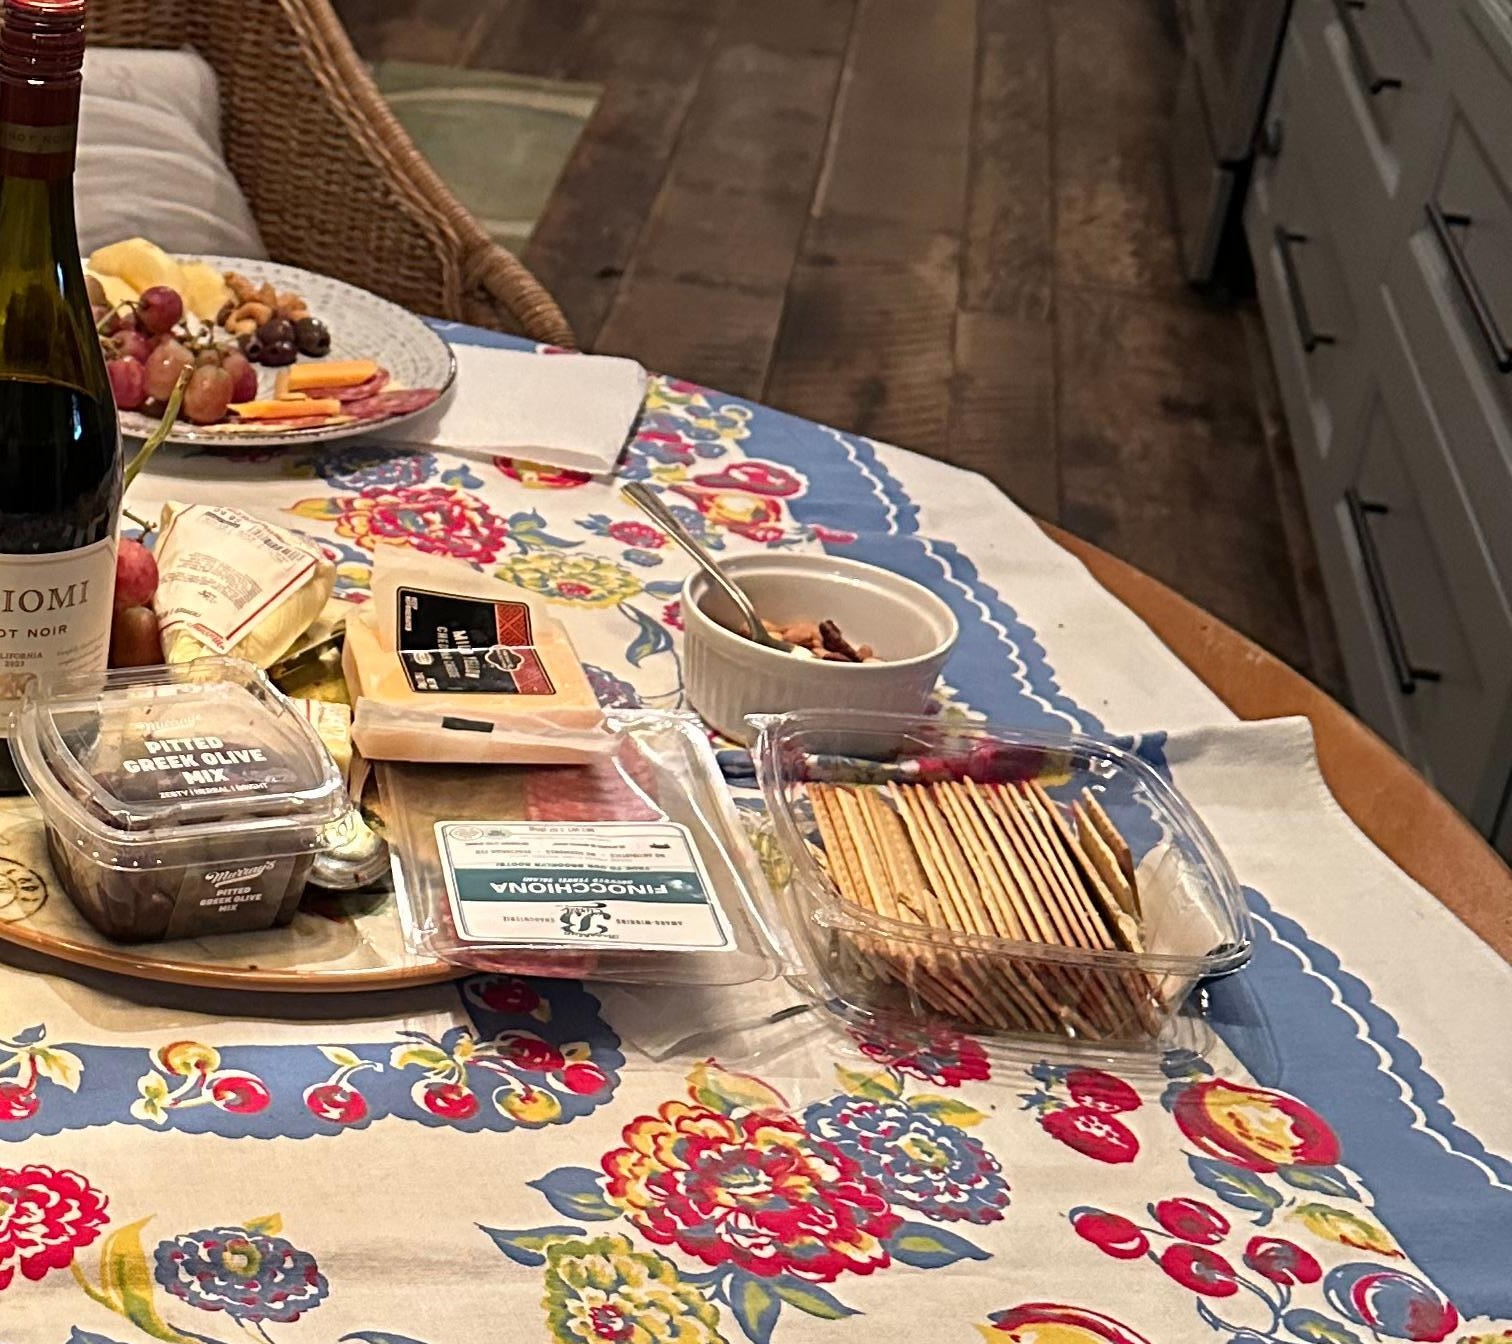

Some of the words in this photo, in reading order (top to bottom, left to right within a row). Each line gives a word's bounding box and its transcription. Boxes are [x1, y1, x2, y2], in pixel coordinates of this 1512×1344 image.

[27, 624, 68, 638] NOIR
[144, 736, 224, 754] PITTED
[122, 754, 199, 773] GREEK
[200, 749, 267, 766] OLIVE
[181, 768, 230, 785] MIX
[159, 790, 189, 799] ZESTY
[205, 860, 277, 887] Murray's
[216, 886, 251, 896] PITTED
[490, 881, 668, 895] FINOCCHIONA
[200, 896, 232, 906] GREEK
[233, 893, 262, 903] OLIVE
[218, 904, 238, 912] MIX
